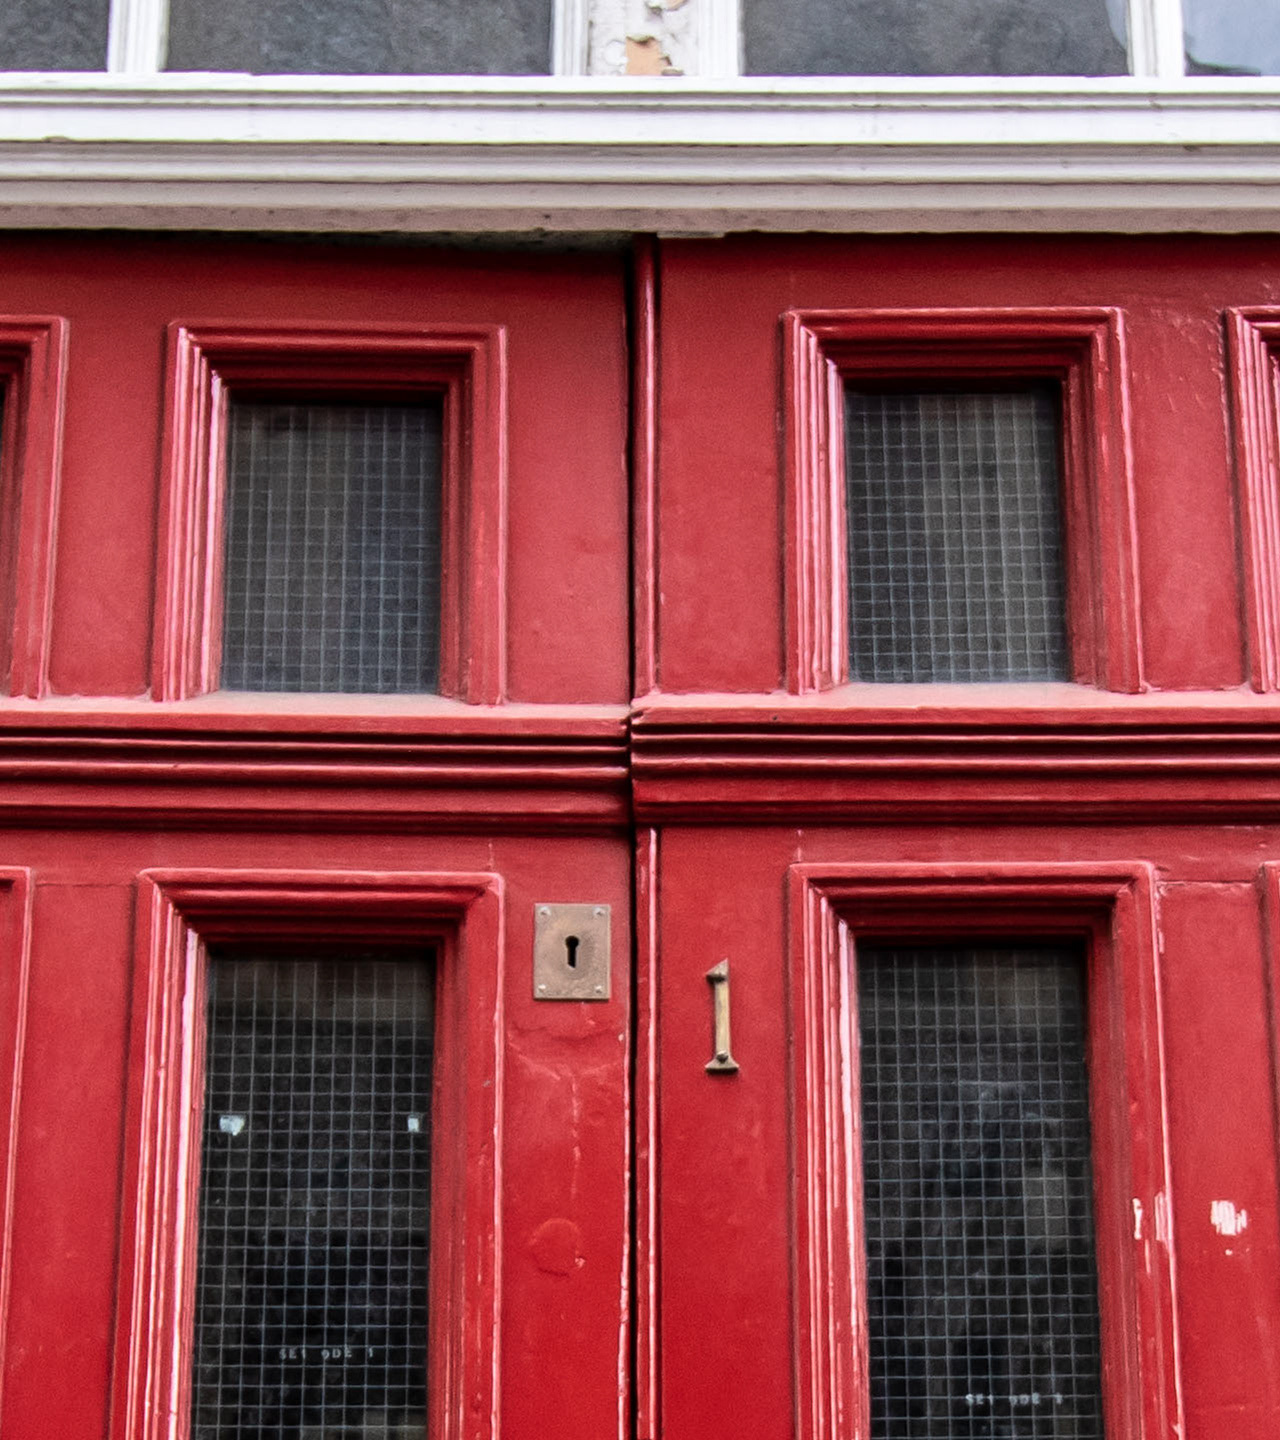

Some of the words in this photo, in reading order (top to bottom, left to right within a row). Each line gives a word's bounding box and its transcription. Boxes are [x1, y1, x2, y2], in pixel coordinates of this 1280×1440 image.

[704, 957, 740, 1074] 1
[279, 1347, 307, 1360] SE1
[965, 1393, 994, 1406] SE1
